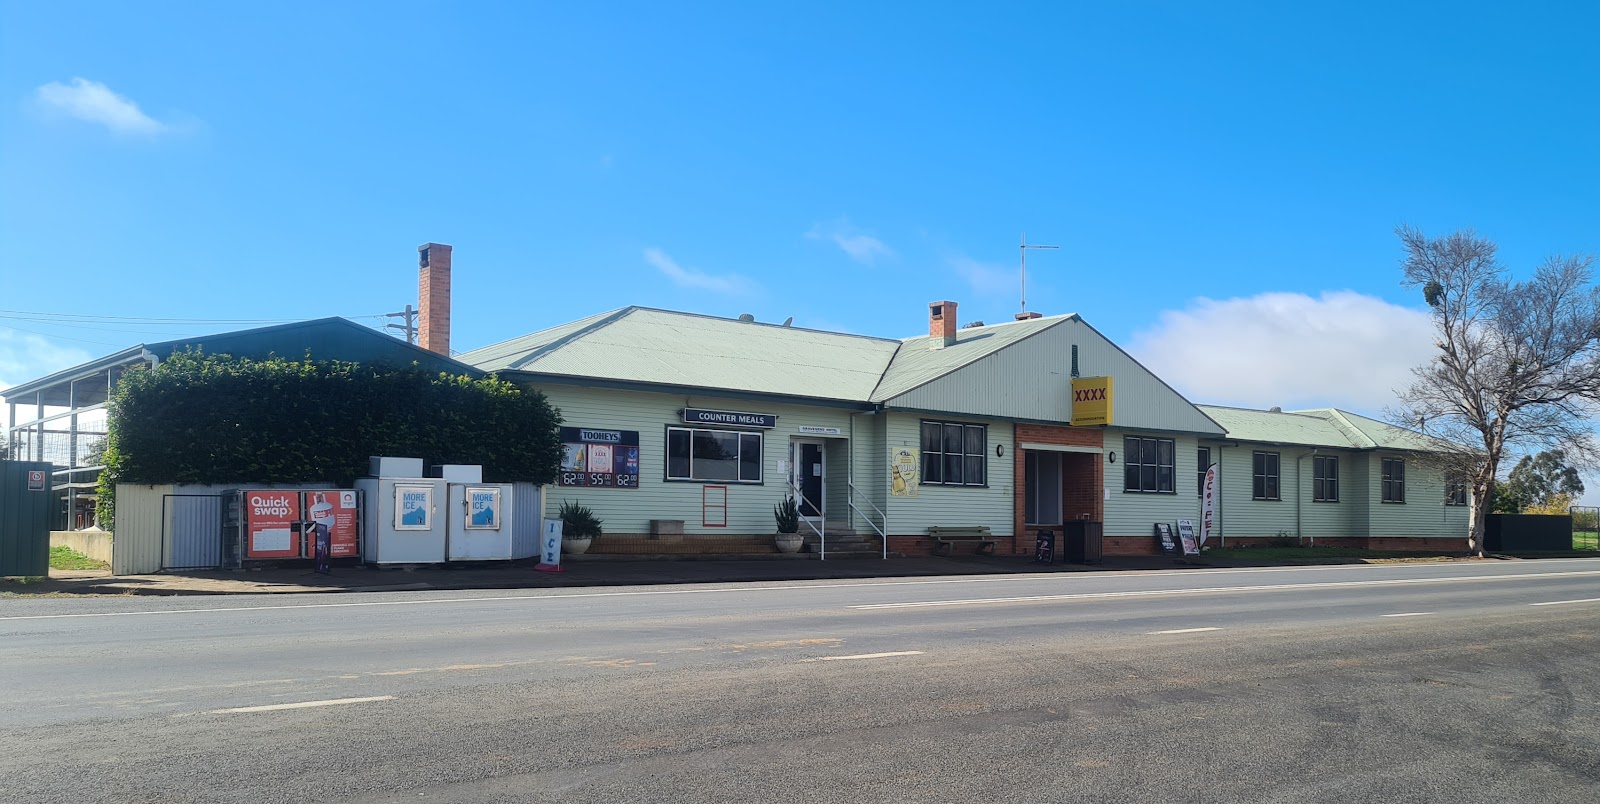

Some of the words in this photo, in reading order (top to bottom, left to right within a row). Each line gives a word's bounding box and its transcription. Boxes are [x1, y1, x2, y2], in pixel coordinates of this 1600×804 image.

[1075, 387, 1106, 402] XXXX
[698, 412, 737, 422] COUNTER
[738, 415, 764, 425] MEALS
[583, 431, 619, 441] TOOHEYS
[251, 496, 289, 507] Quick
[403, 493, 426, 501] MORE
[472, 493, 494, 502] MORE
[403, 501, 415, 510] ICE
[472, 501, 484, 510] ICE
[254, 507, 288, 518] swap
